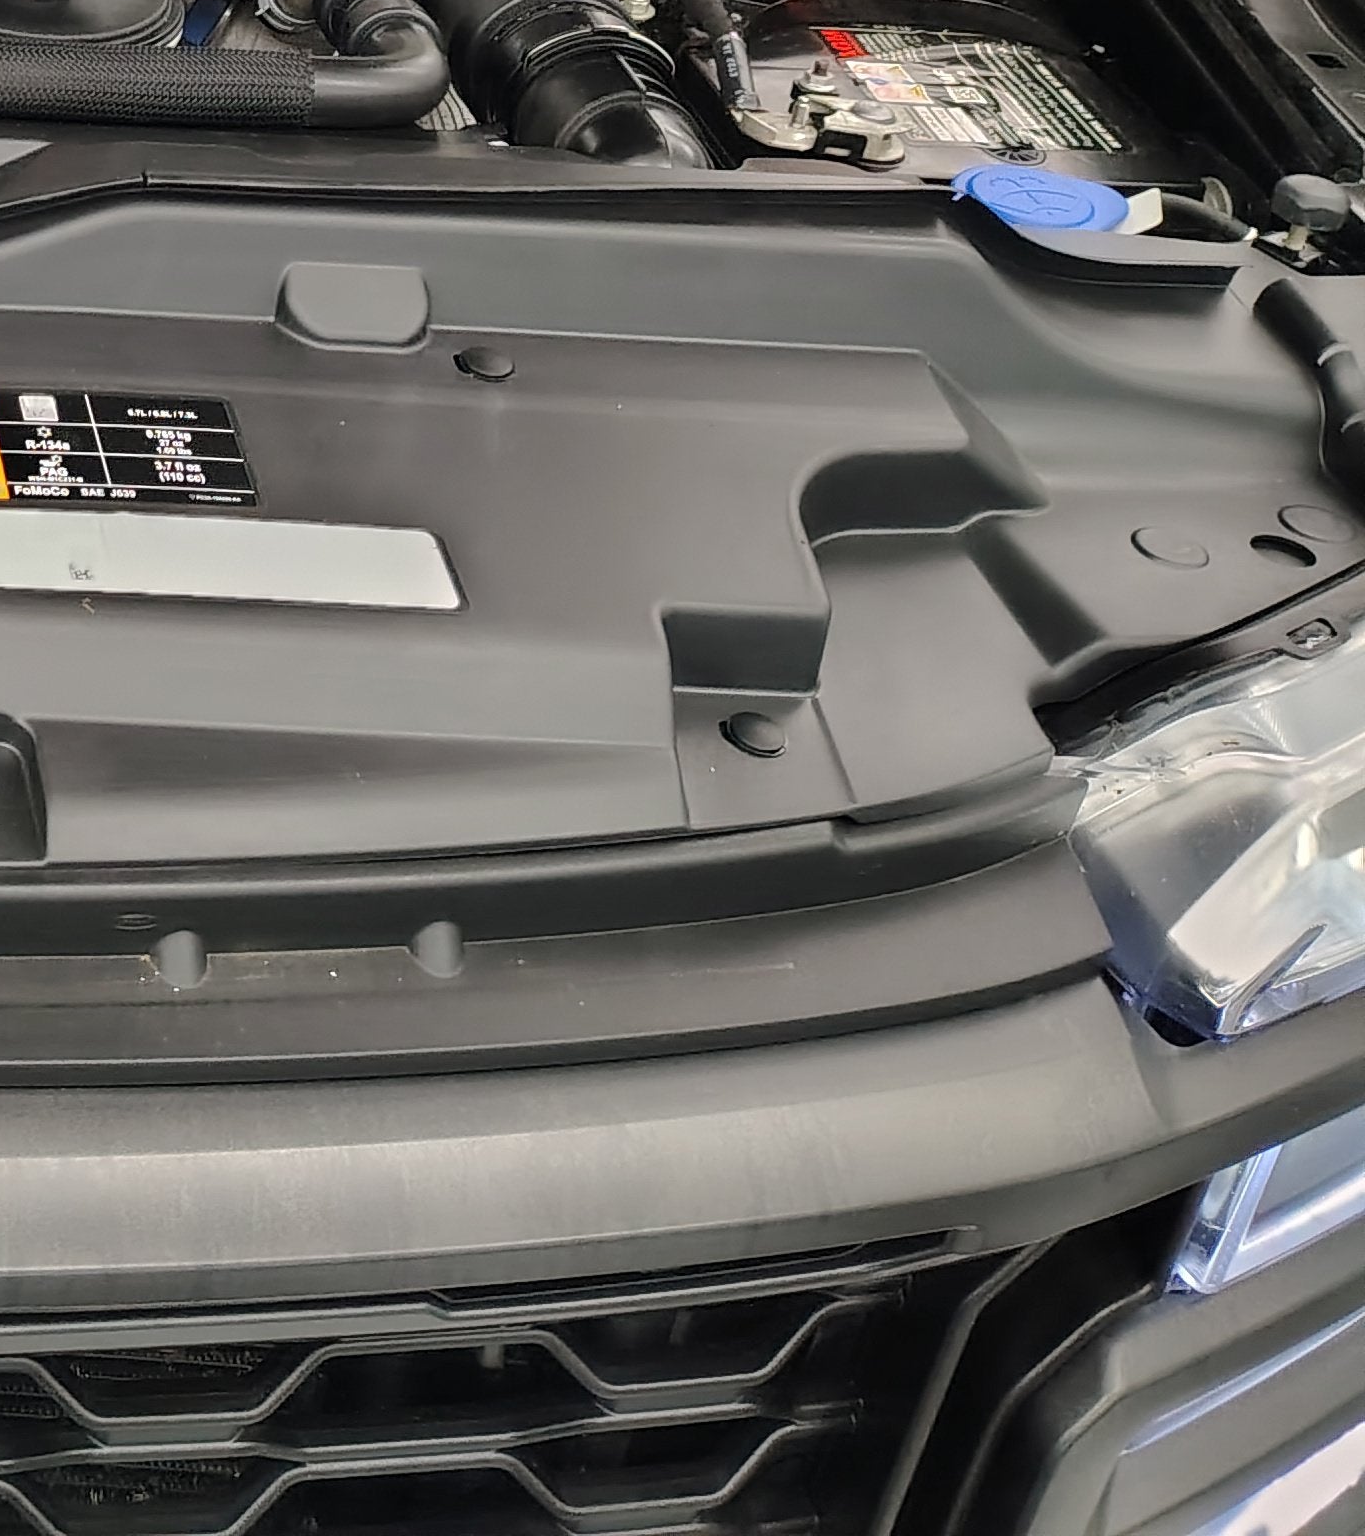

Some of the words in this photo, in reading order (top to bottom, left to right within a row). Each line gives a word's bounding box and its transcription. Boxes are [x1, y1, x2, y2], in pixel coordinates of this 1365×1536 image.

[25, 440, 70, 450] R-134a
[40, 467, 68, 476] PAG
[154, 462, 172, 471] 3.7
[159, 472, 184, 482] (110
[186, 473, 205, 484] cc)
[14, 486, 69, 496] FoMoCo
[80, 488, 105, 496] SAE
[110, 489, 136, 498] J639
